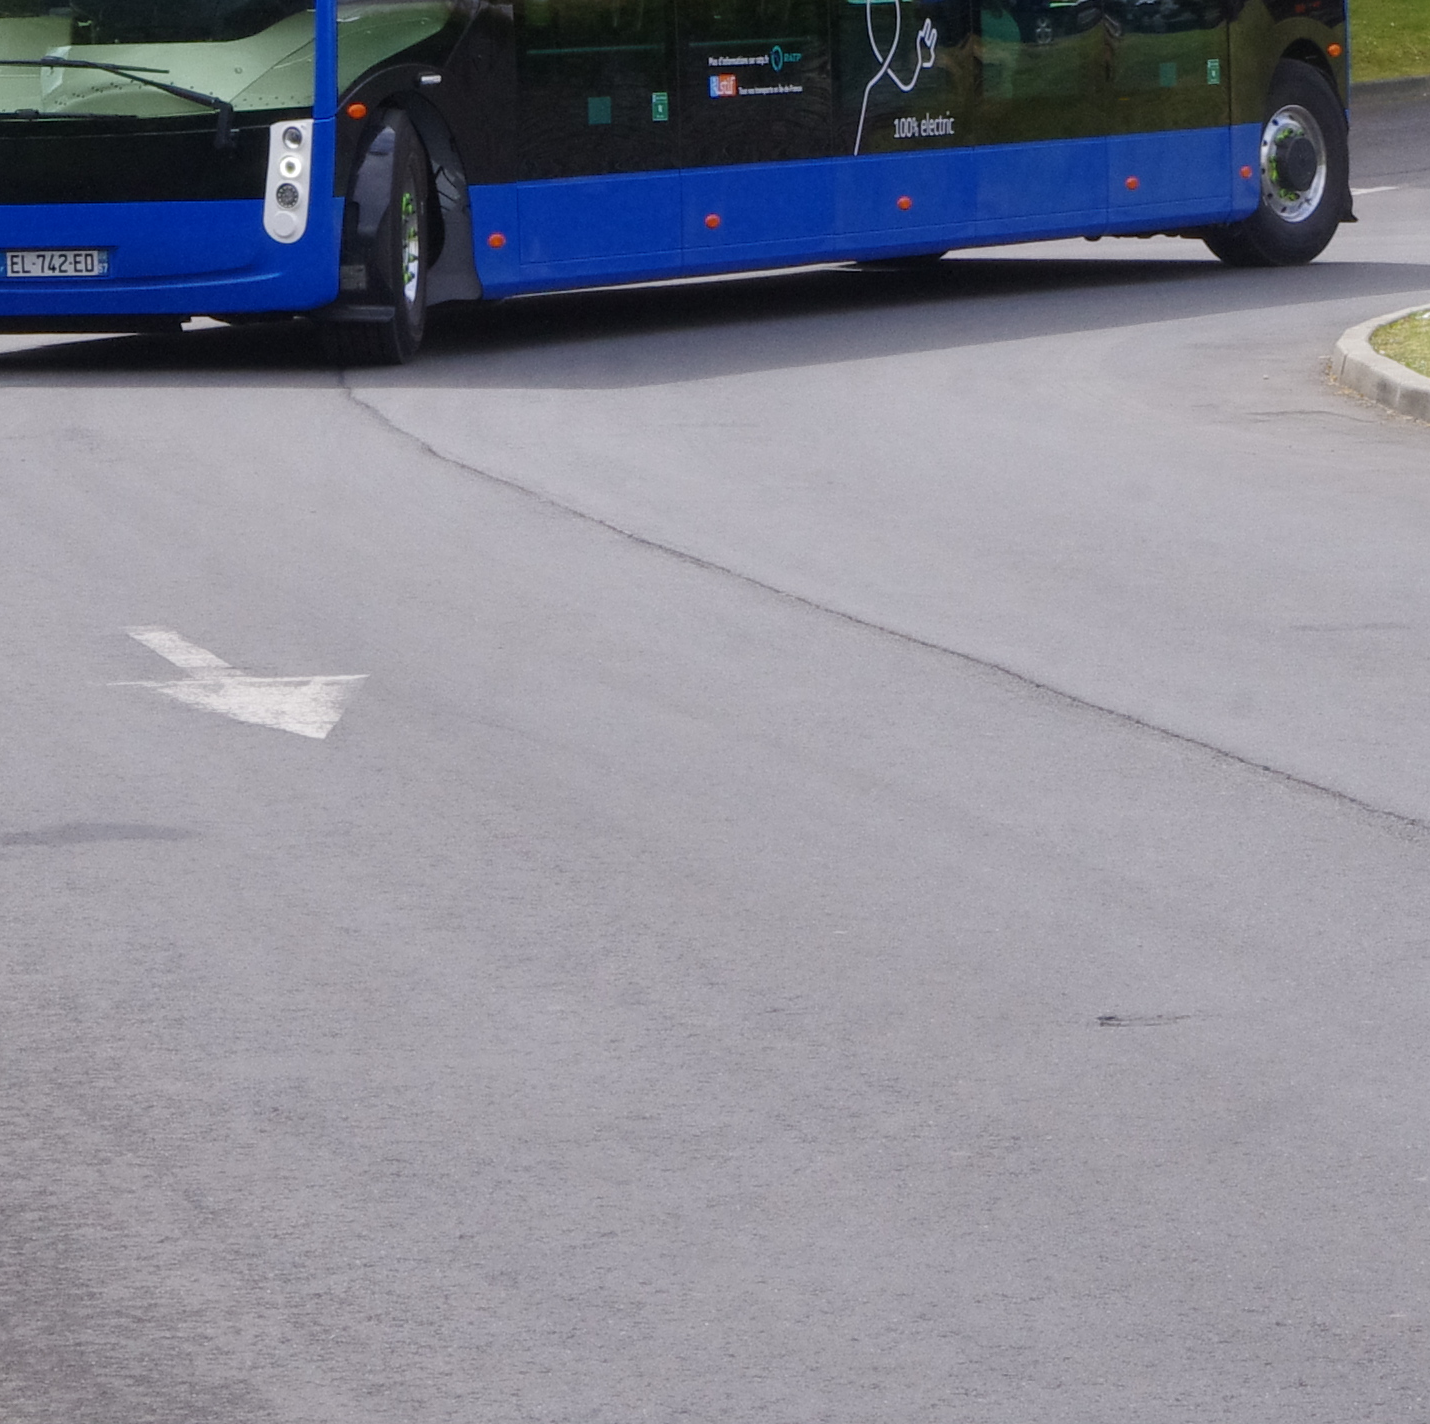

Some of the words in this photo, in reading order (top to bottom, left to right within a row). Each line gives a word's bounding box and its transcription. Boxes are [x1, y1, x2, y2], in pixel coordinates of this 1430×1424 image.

[783, 53, 802, 63] RATP
[894, 117, 918, 138] 100%
[921, 110, 955, 137] electric
[10, 253, 95, 274] EL-742-ED
